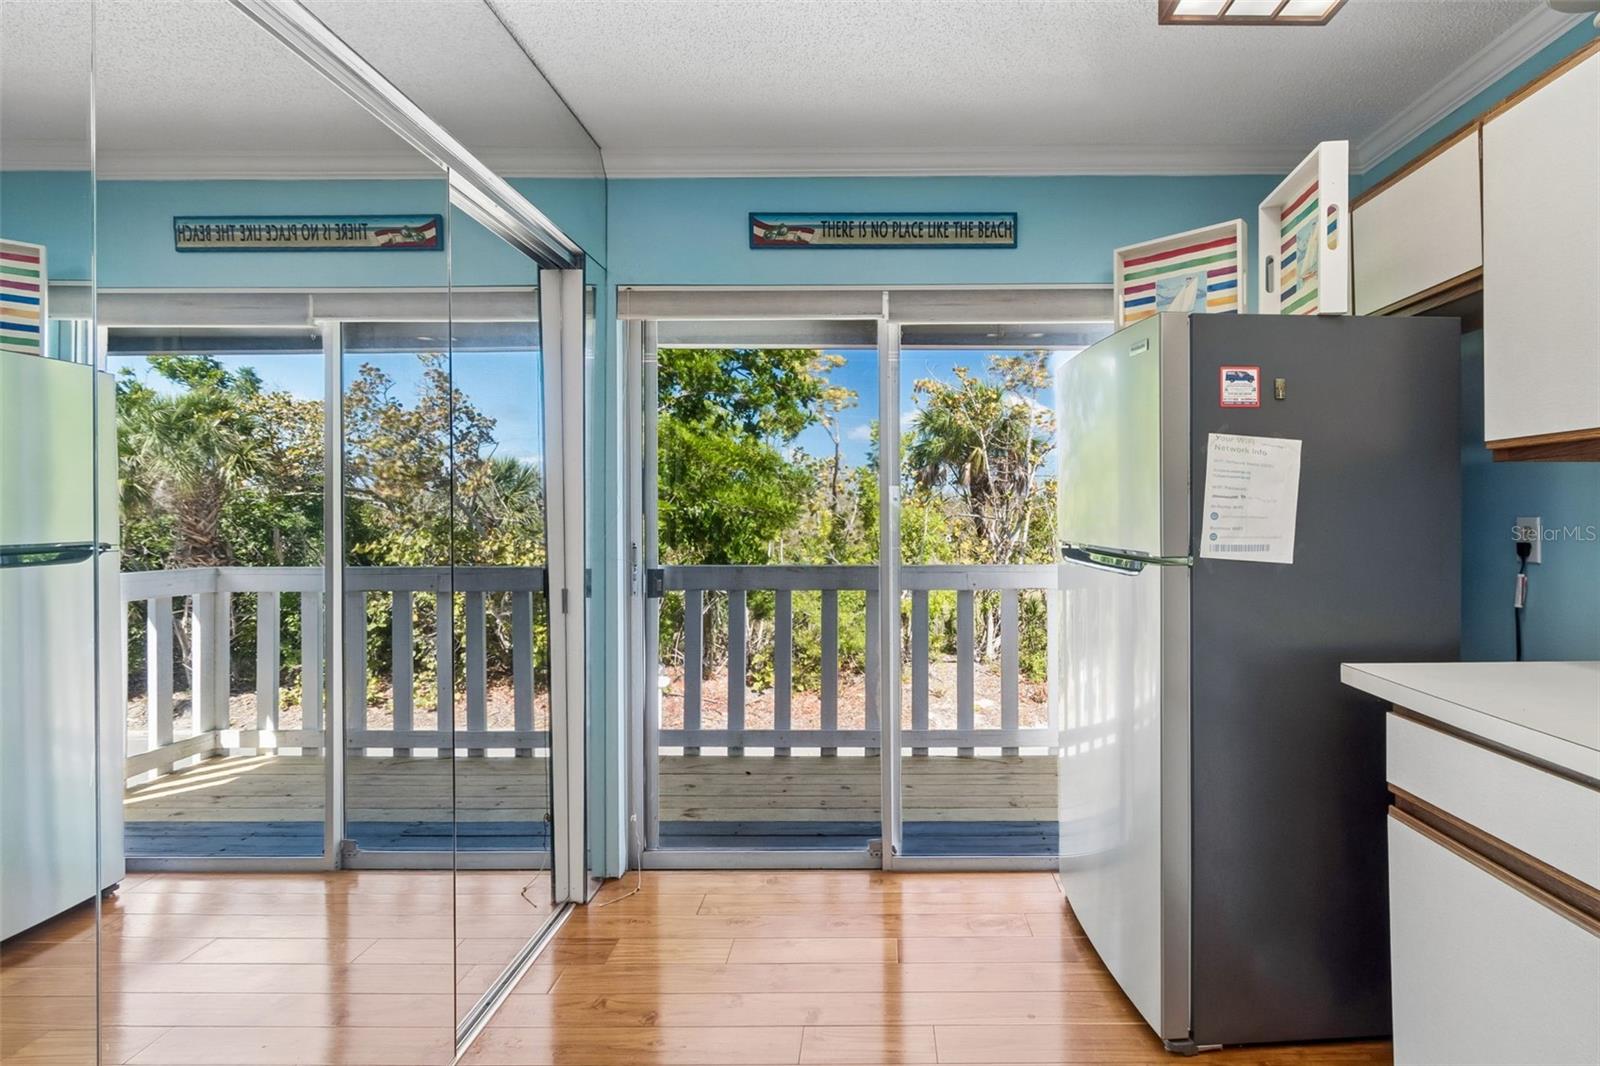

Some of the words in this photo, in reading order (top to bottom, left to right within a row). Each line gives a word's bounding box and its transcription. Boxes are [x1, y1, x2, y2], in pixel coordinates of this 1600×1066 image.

[820, 220, 854, 238] THERE
[858, 220, 867, 239] IS
[871, 220, 889, 239] NO
[892, 221, 924, 239] PLACE
[927, 221, 949, 239] LIKE
[953, 221, 974, 239] THE
[978, 221, 1013, 239] BEACH
[1214, 444, 1249, 454] Network
